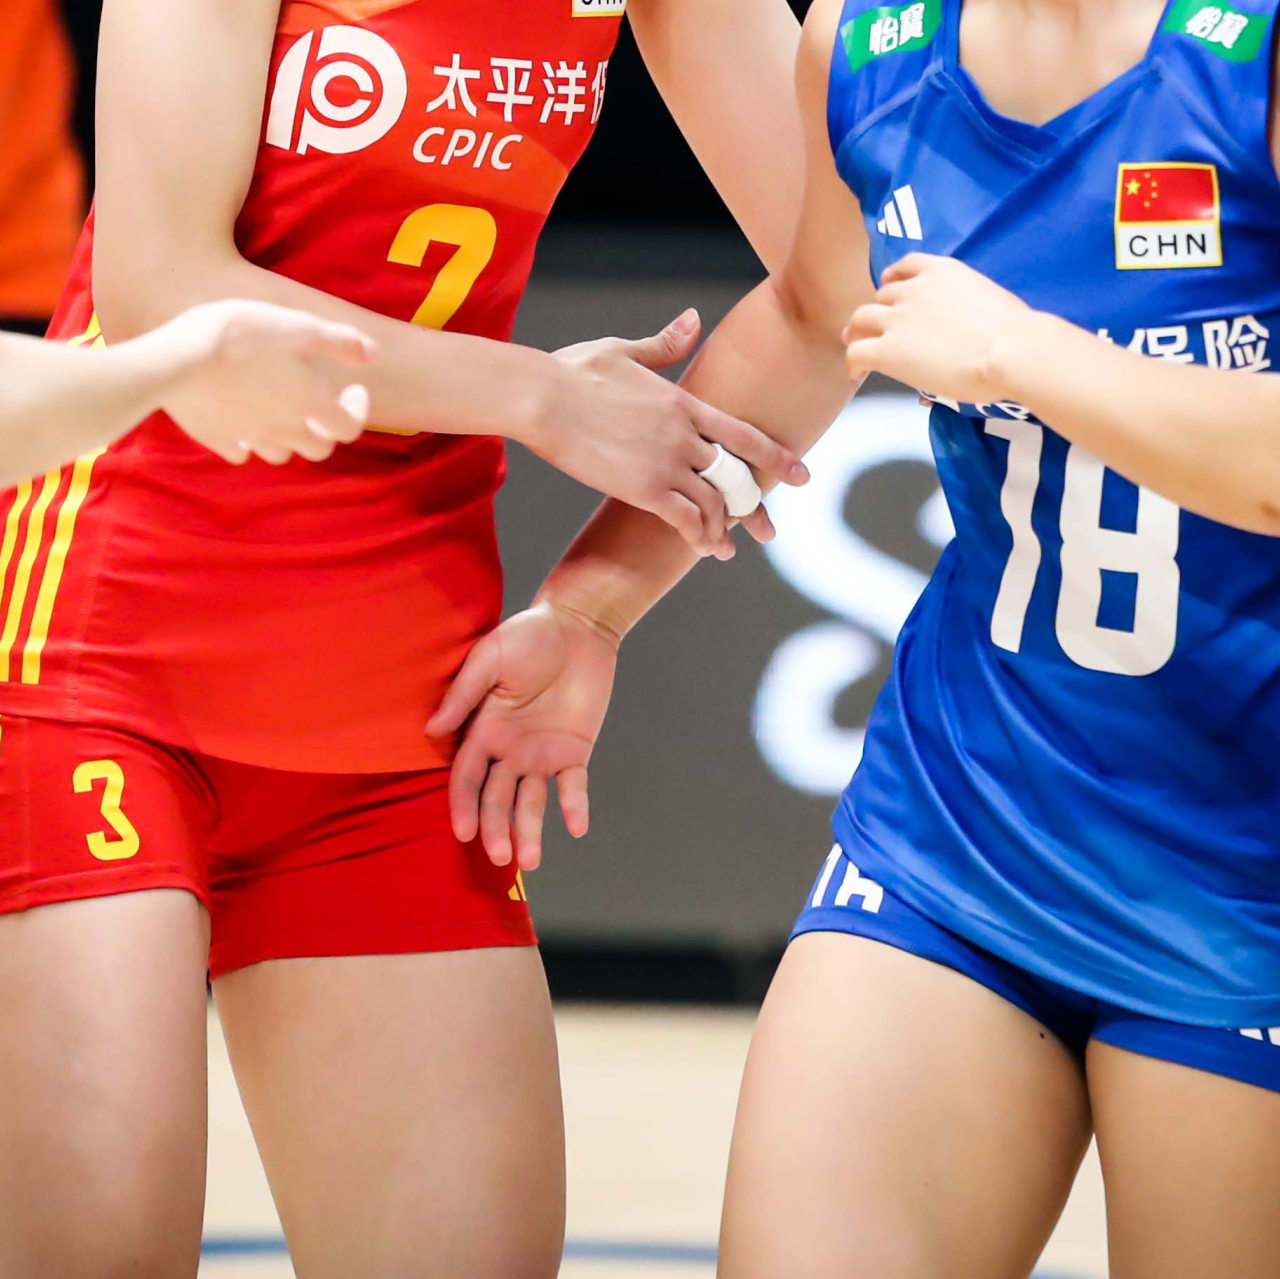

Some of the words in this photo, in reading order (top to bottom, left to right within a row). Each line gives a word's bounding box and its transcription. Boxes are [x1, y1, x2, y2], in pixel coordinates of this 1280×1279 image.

[411, 125, 523, 171] CPIC
[1128, 233, 1207, 258] CHN
[983, 417, 1181, 677] 18
[72, 758, 142, 861] 3
